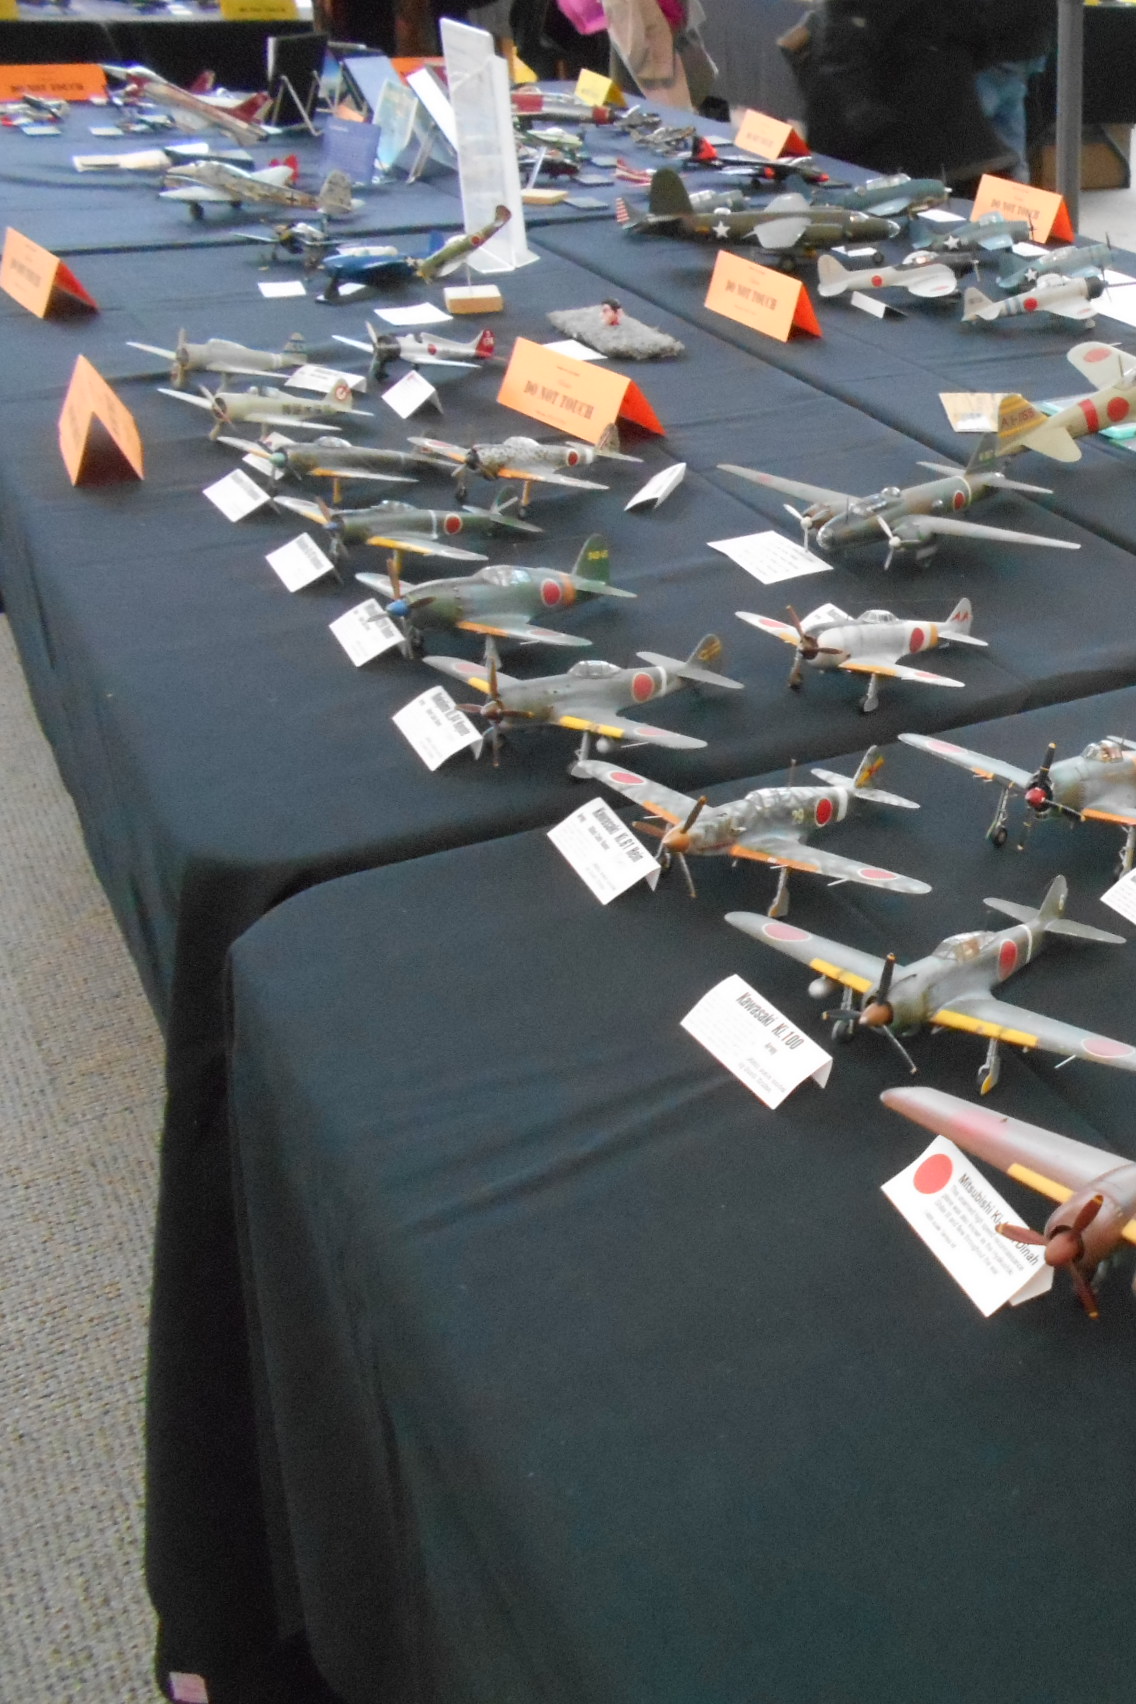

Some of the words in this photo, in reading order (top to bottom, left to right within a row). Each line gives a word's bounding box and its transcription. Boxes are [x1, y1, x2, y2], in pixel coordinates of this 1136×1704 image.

[735, 990, 778, 1028] Kawasaki
[770, 1021, 804, 1051] Ki.100
[956, 1173, 996, 1214] Mitsubishi
